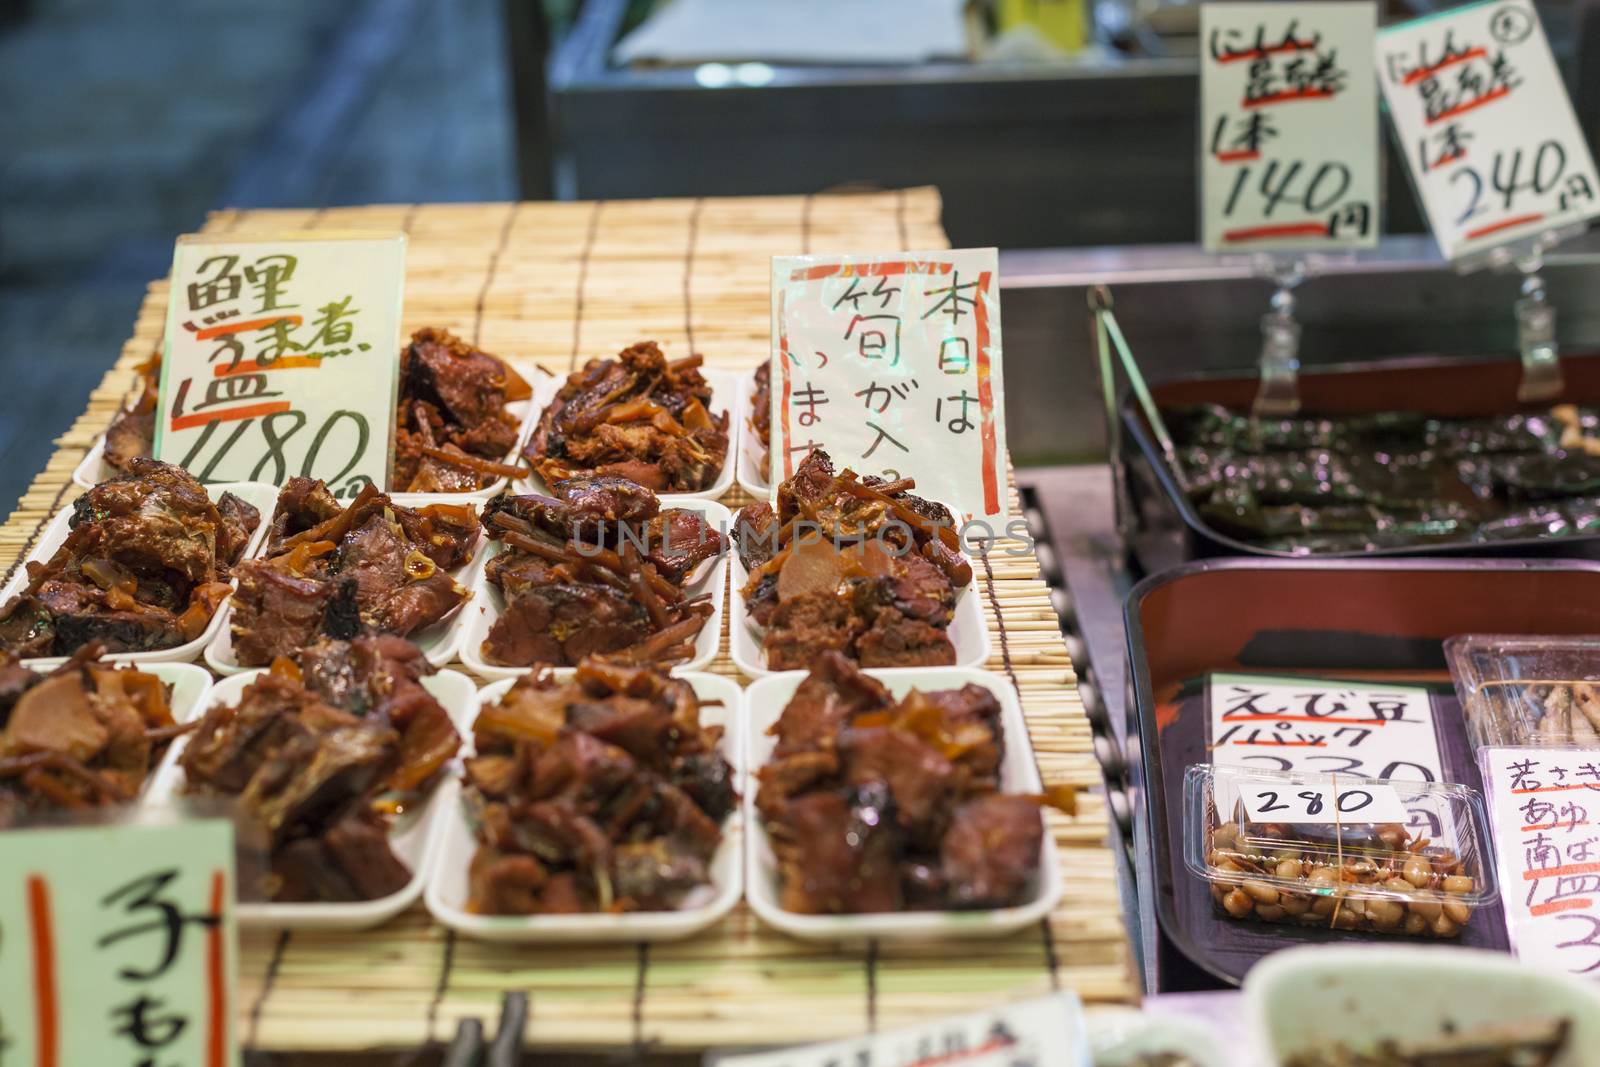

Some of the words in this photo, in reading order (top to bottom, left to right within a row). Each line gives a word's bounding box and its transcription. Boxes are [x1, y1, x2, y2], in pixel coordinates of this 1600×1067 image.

[182, 255, 301, 331] 鯉
[208, 296, 372, 372] うま煮
[920, 271, 980, 434] 本日は
[171, 374, 284, 418] 1皿
[1222, 686, 1425, 723] えび豆
[1257, 790, 1374, 816] 280
[1519, 798, 1588, 833] あゆ
[97, 866, 221, 1067] 子も
